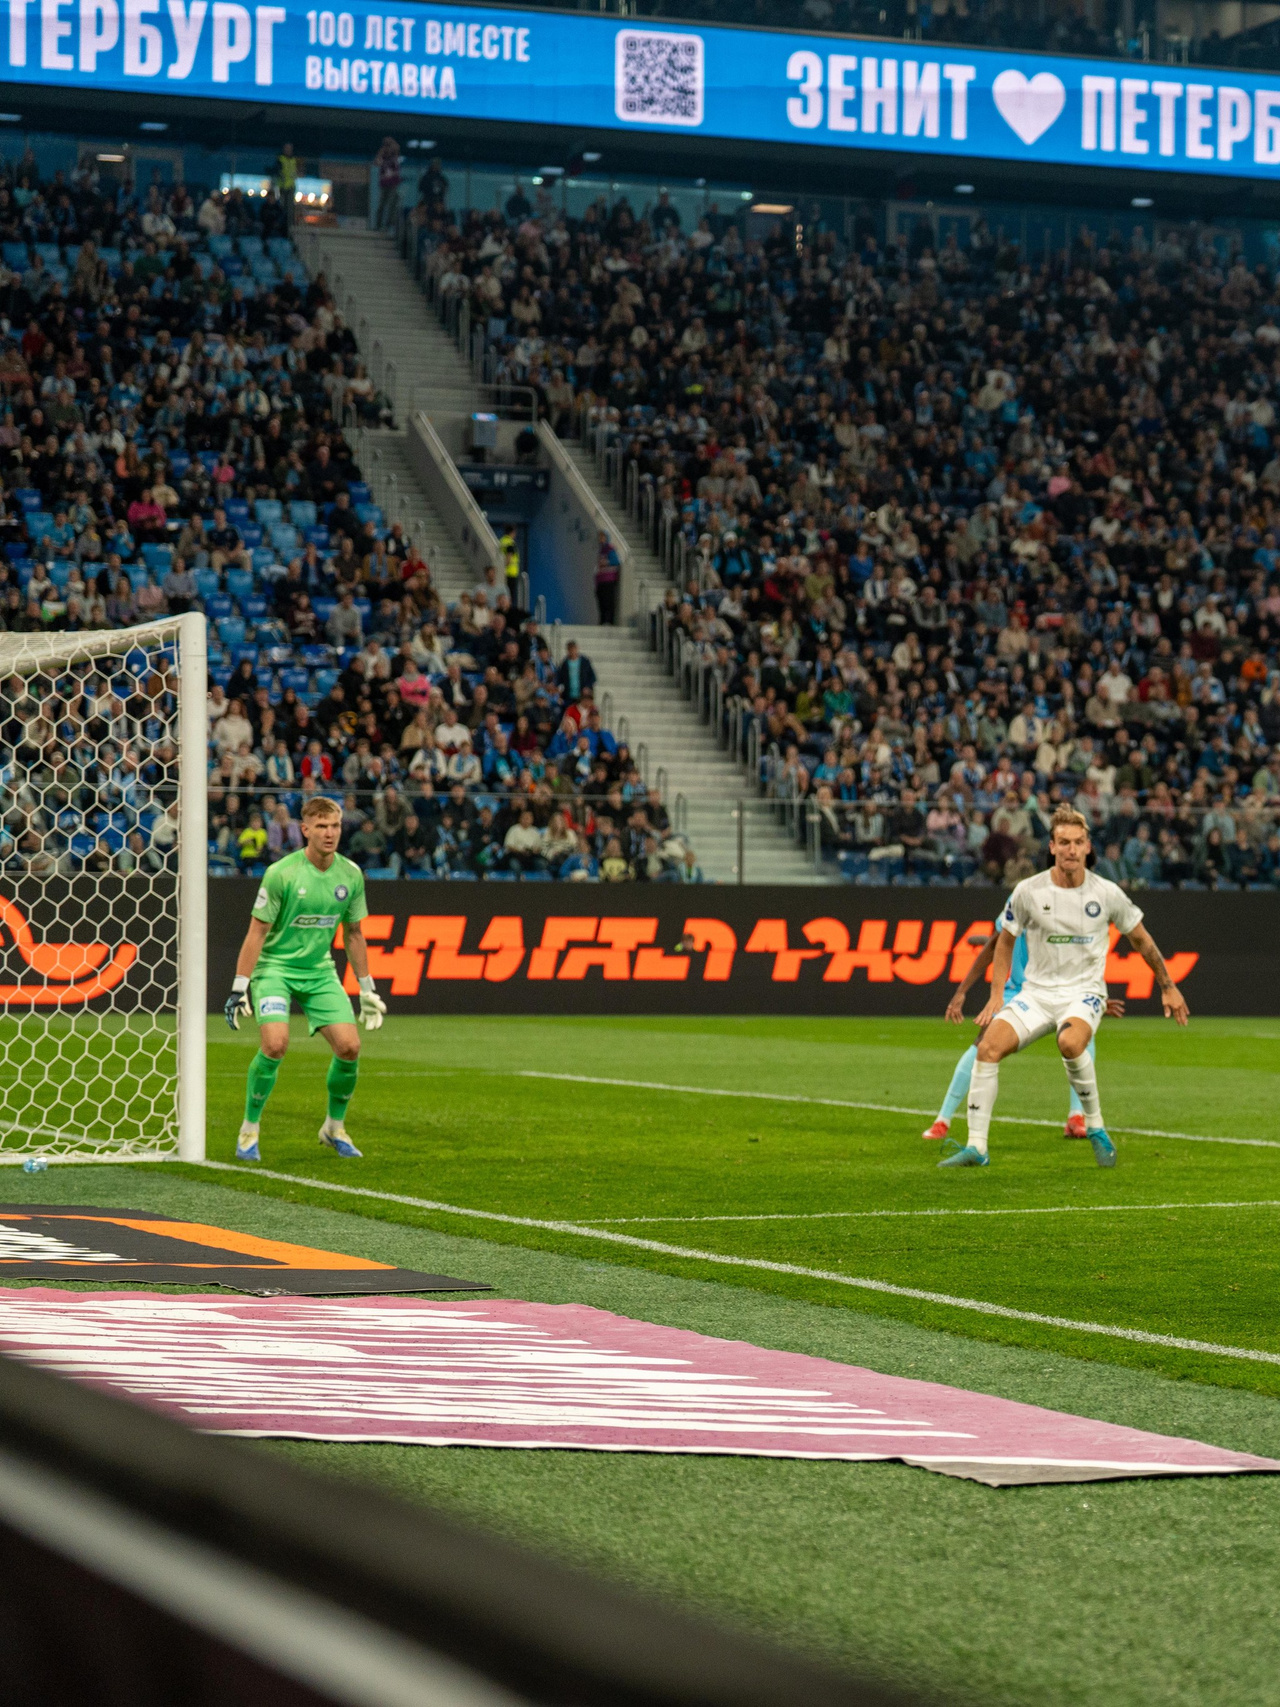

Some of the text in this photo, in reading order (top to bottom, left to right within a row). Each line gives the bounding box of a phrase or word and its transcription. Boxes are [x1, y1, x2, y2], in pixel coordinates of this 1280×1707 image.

[306, 10, 531, 62] 100 ЛЕТ ВМЕСТЕ
[305, 55, 458, 101] ВЫСТАВКА
[786, 50, 976, 141] ЗЕНИТ
